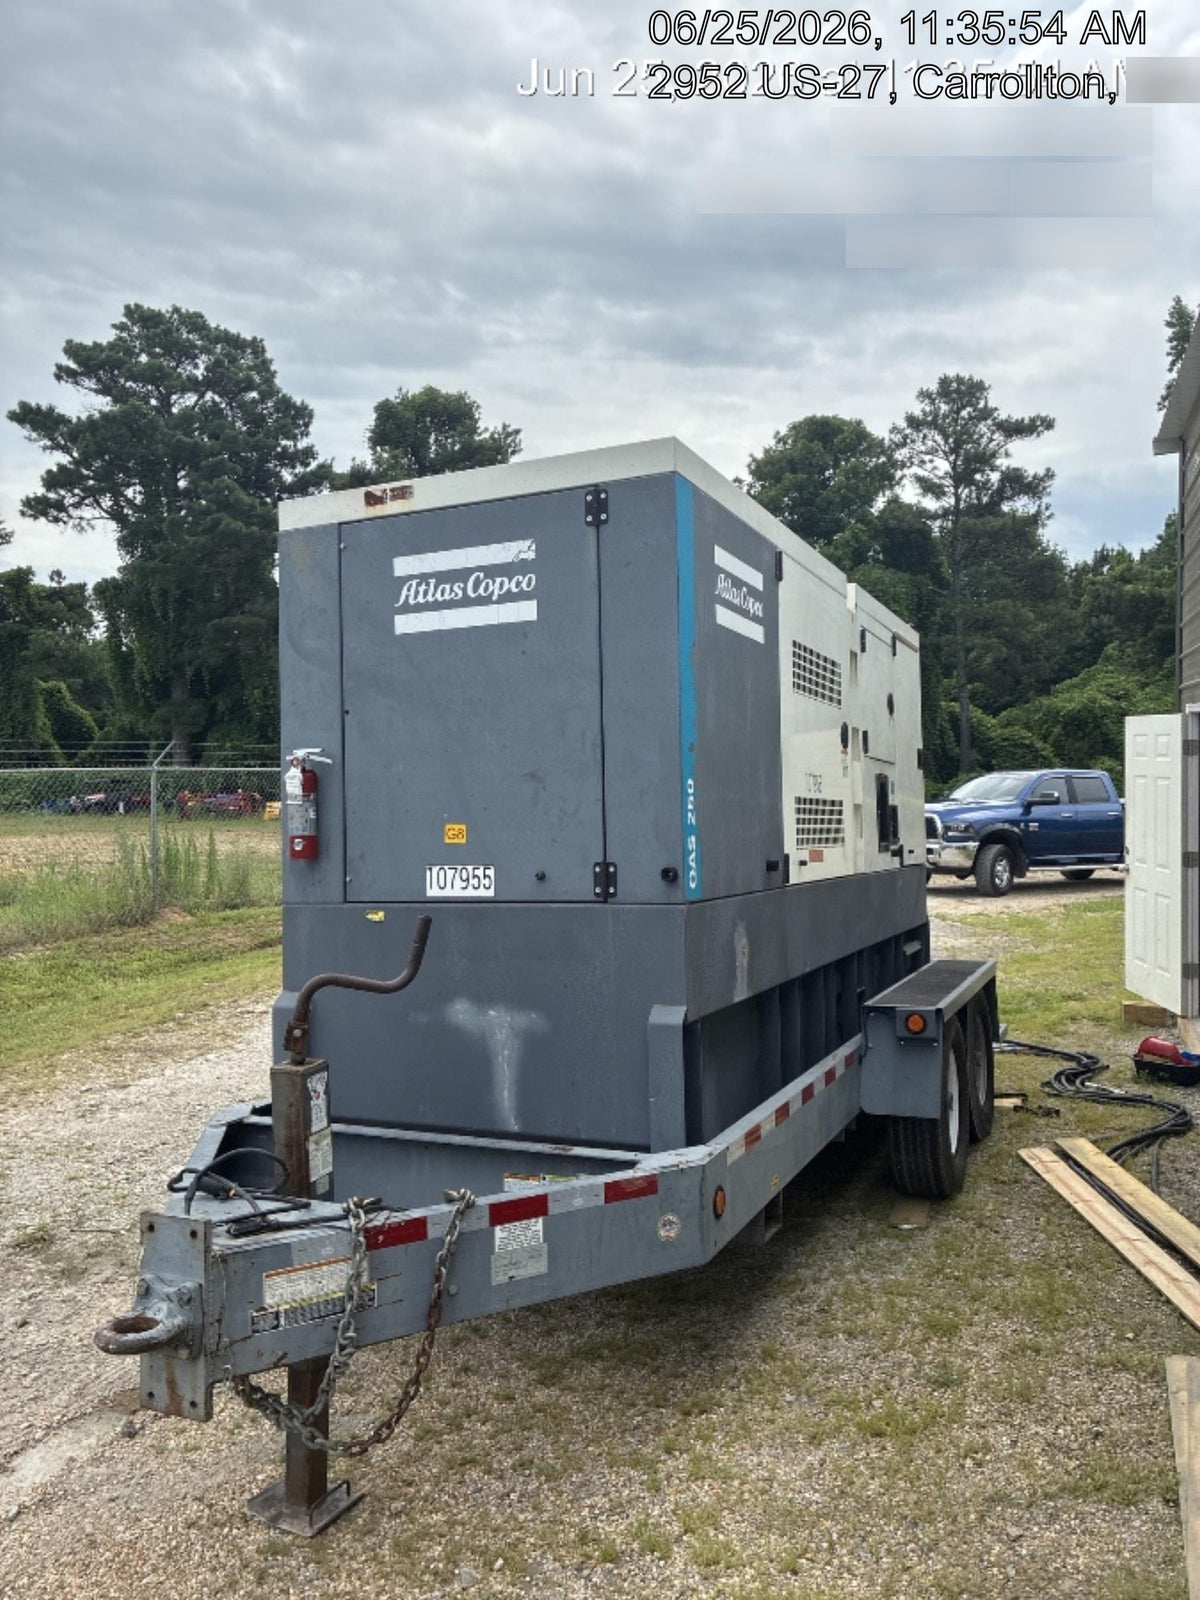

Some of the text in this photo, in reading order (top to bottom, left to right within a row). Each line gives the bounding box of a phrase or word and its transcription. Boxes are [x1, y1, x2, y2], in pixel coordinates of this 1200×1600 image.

[394, 571, 536, 607] Atlas Copco
[446, 827, 465, 840] G8
[427, 866, 492, 890] 107955
